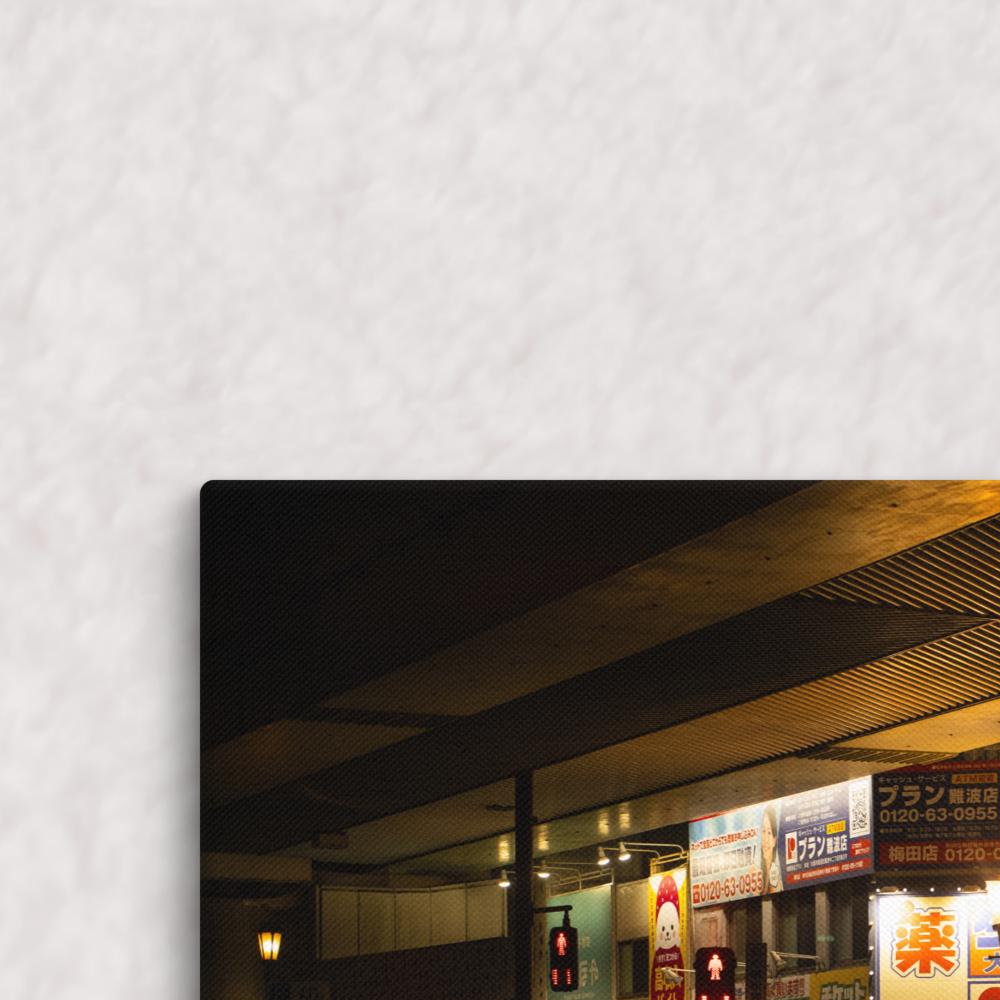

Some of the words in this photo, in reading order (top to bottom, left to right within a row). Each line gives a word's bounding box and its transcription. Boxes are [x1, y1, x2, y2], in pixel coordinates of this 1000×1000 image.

[878, 784, 945, 807] プラン
[879, 806, 998, 824] 0120-63-0955
[799, 836, 826, 861] プラン
[888, 845, 939, 862] 梅田店
[700, 870, 763, 902] 0120-63-0955
[895, 911, 956, 974] 薬
